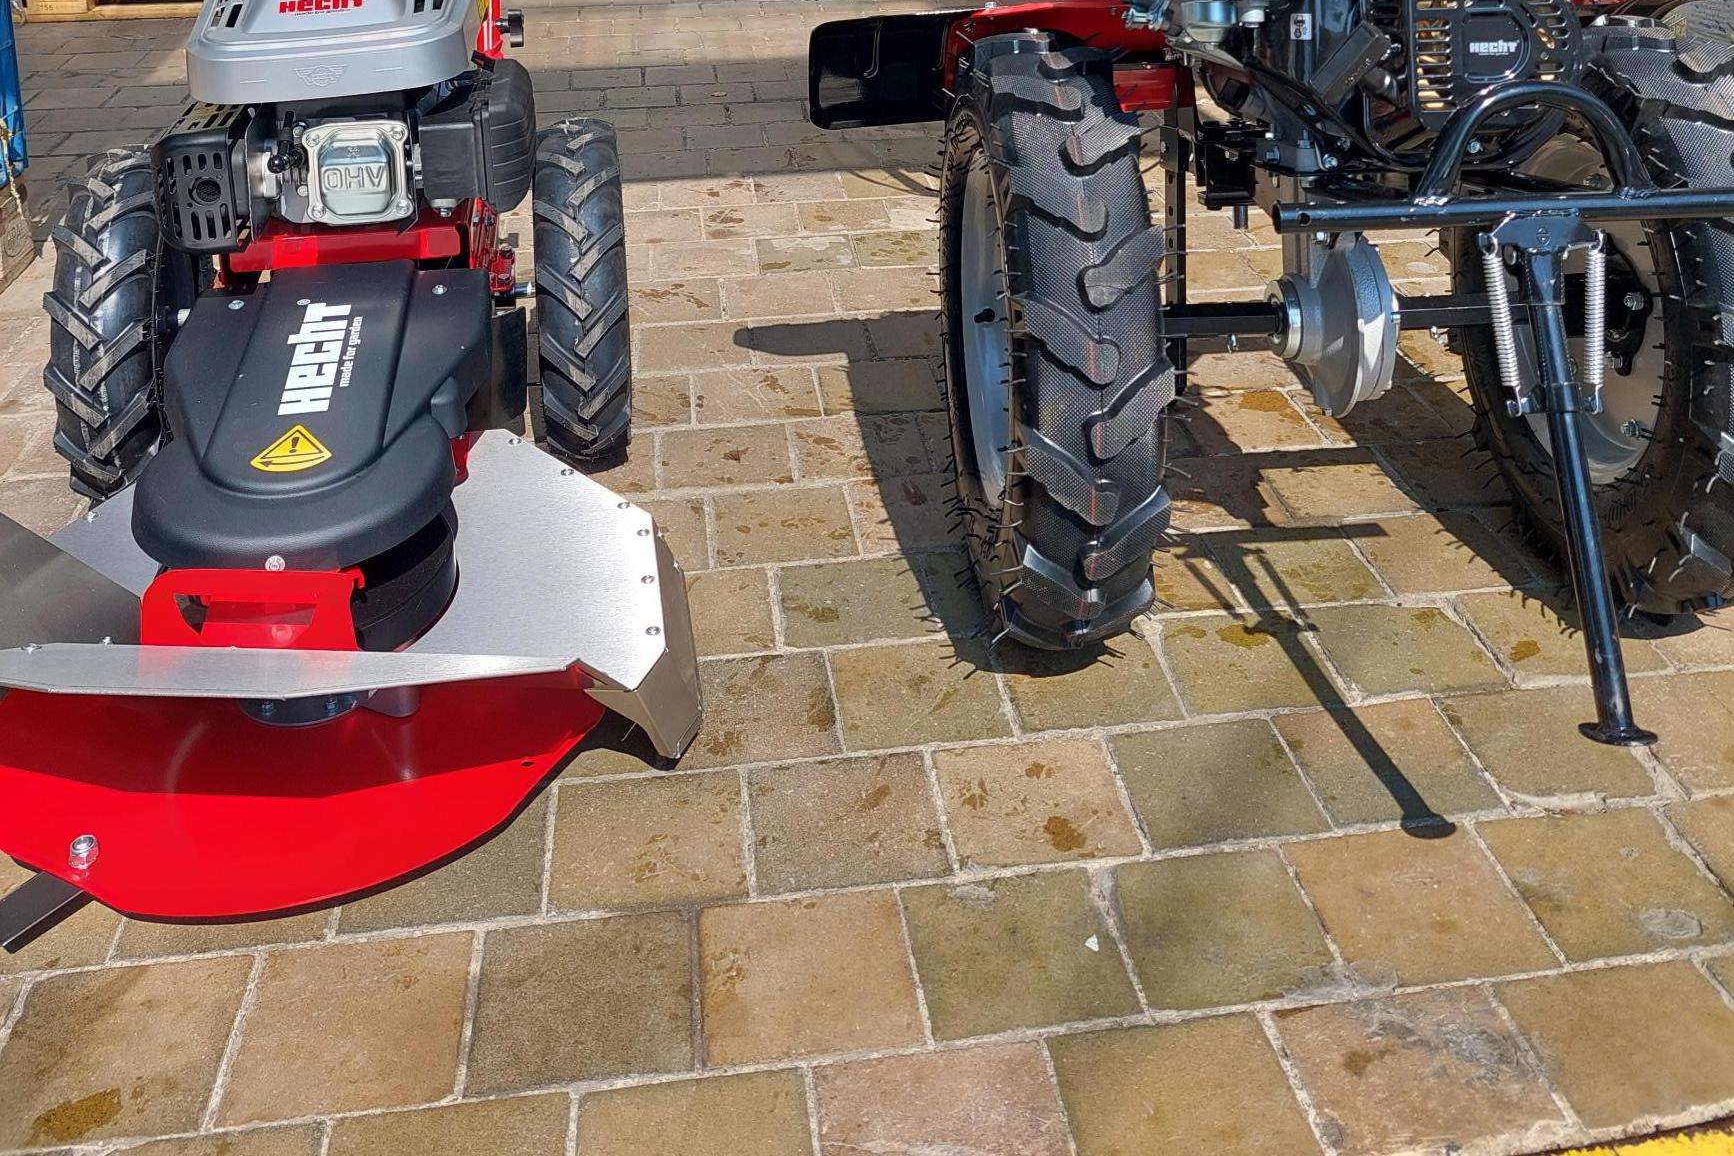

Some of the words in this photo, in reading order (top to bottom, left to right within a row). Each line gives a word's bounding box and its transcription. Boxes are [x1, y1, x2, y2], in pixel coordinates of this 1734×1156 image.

[322, 164, 386, 191] OHV
[348, 316, 364, 346] garden
[342, 346, 357, 360] for
[339, 360, 354, 388] made
